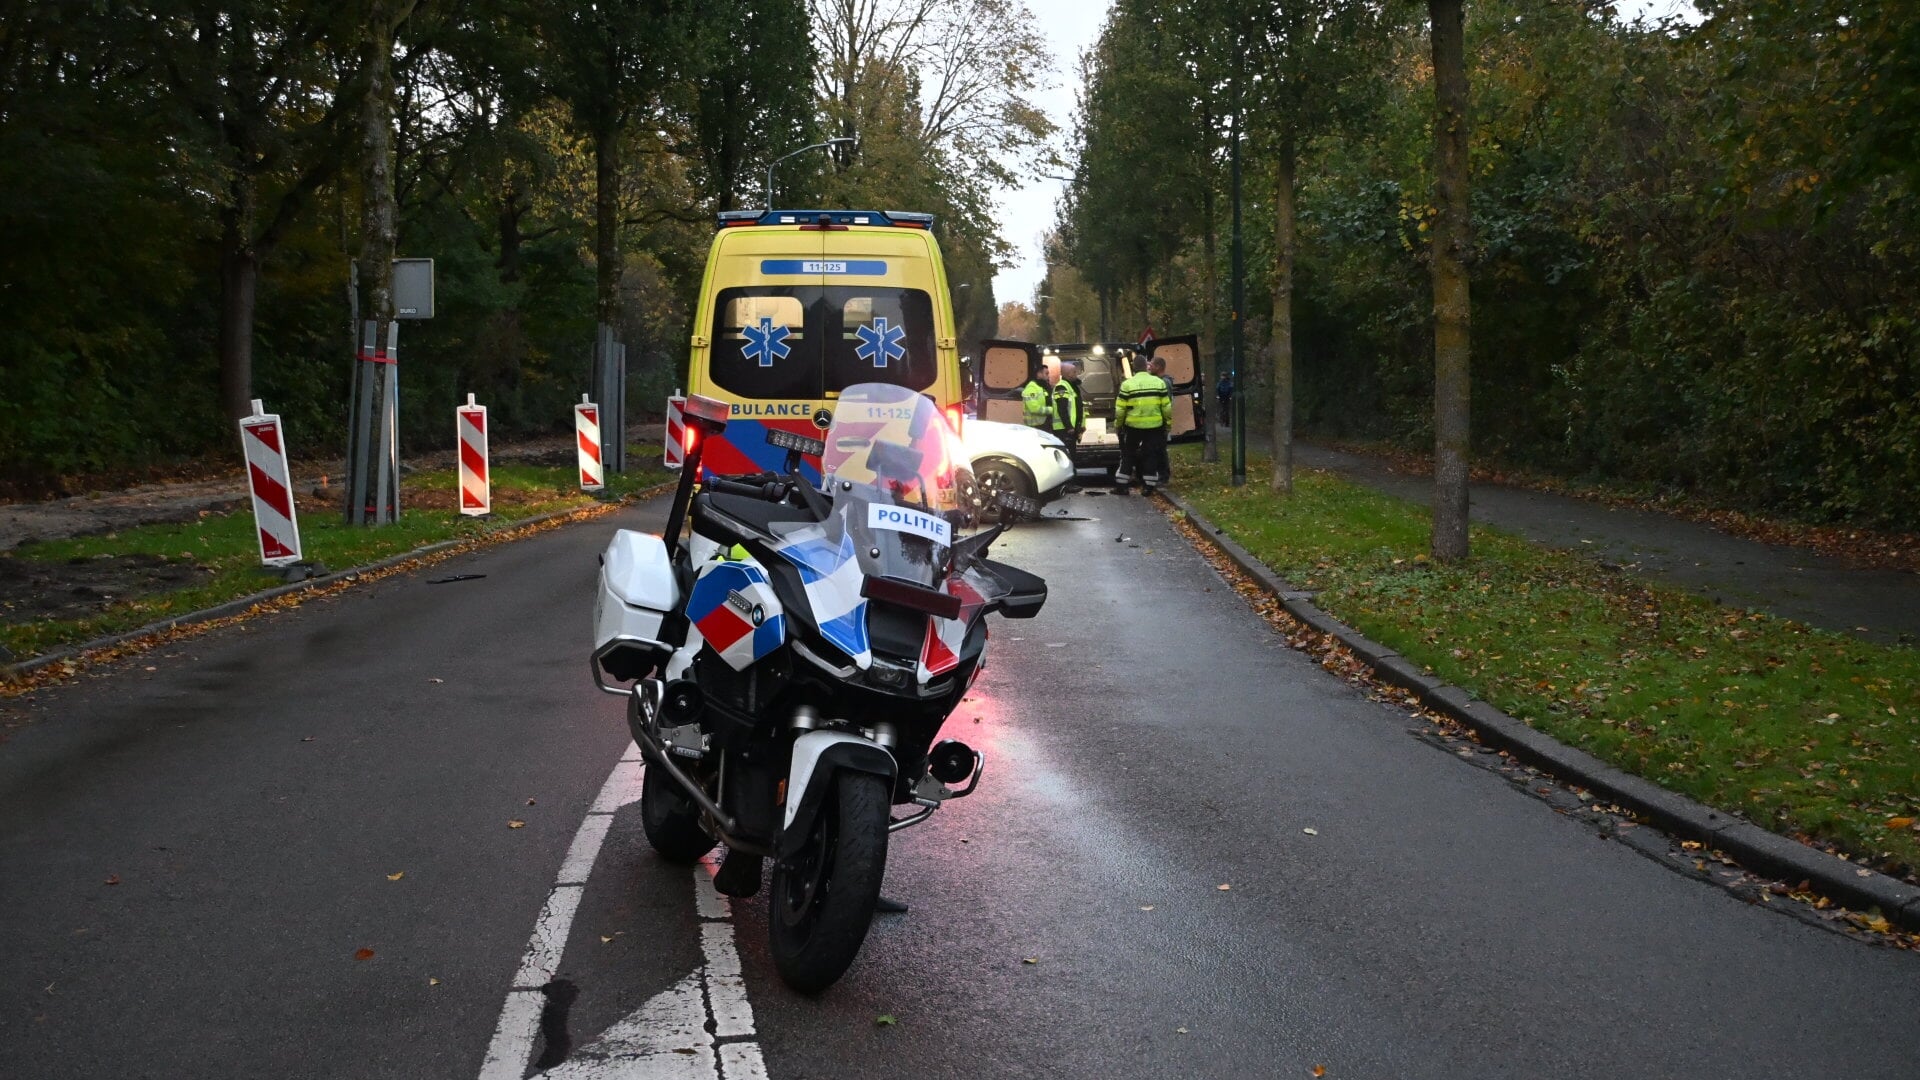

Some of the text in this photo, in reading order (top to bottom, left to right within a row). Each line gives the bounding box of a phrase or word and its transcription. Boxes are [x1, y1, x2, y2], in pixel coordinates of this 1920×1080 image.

[809, 263, 841, 272] 11-125
[731, 403, 811, 416] BULANCE
[867, 407, 912, 420] 11-125
[878, 509, 943, 536] POLITIE
